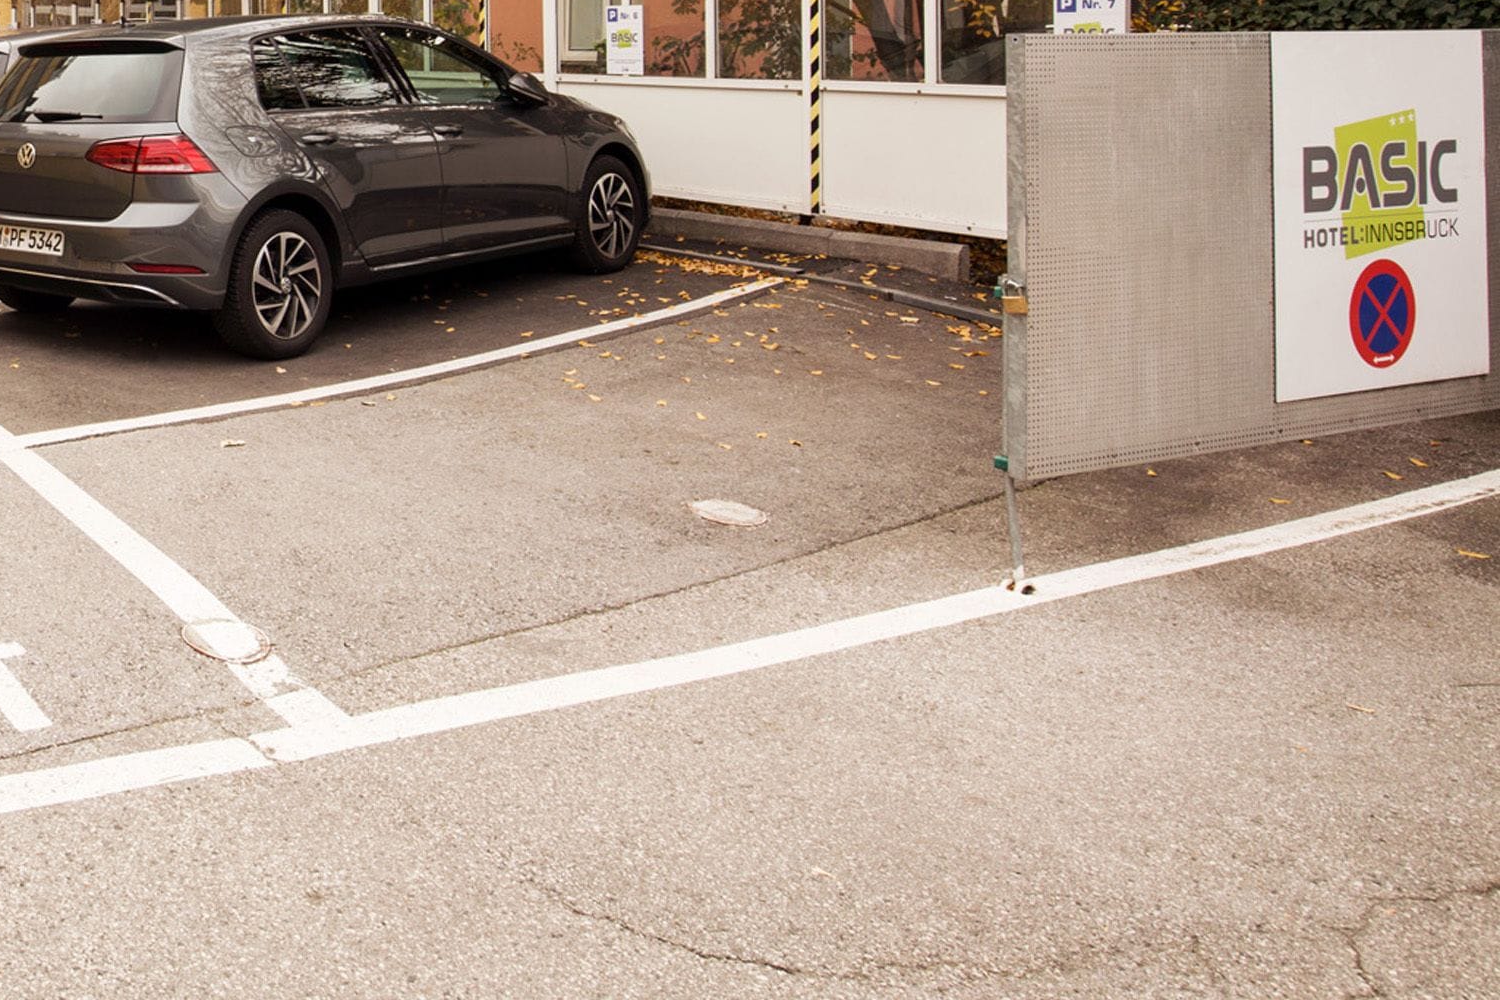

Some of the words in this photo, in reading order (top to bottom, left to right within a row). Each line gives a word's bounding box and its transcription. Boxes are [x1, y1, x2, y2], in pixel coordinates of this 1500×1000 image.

[1082, 0, 1102, 9] Nr.
[1108, 0, 1116, 9] 7
[611, 33, 638, 42] BASIC
[1303, 139, 1458, 214] BASIC
[29, 230, 62, 252] 5342
[1304, 217, 1460, 249] HOTEL:INNSBRUCK
